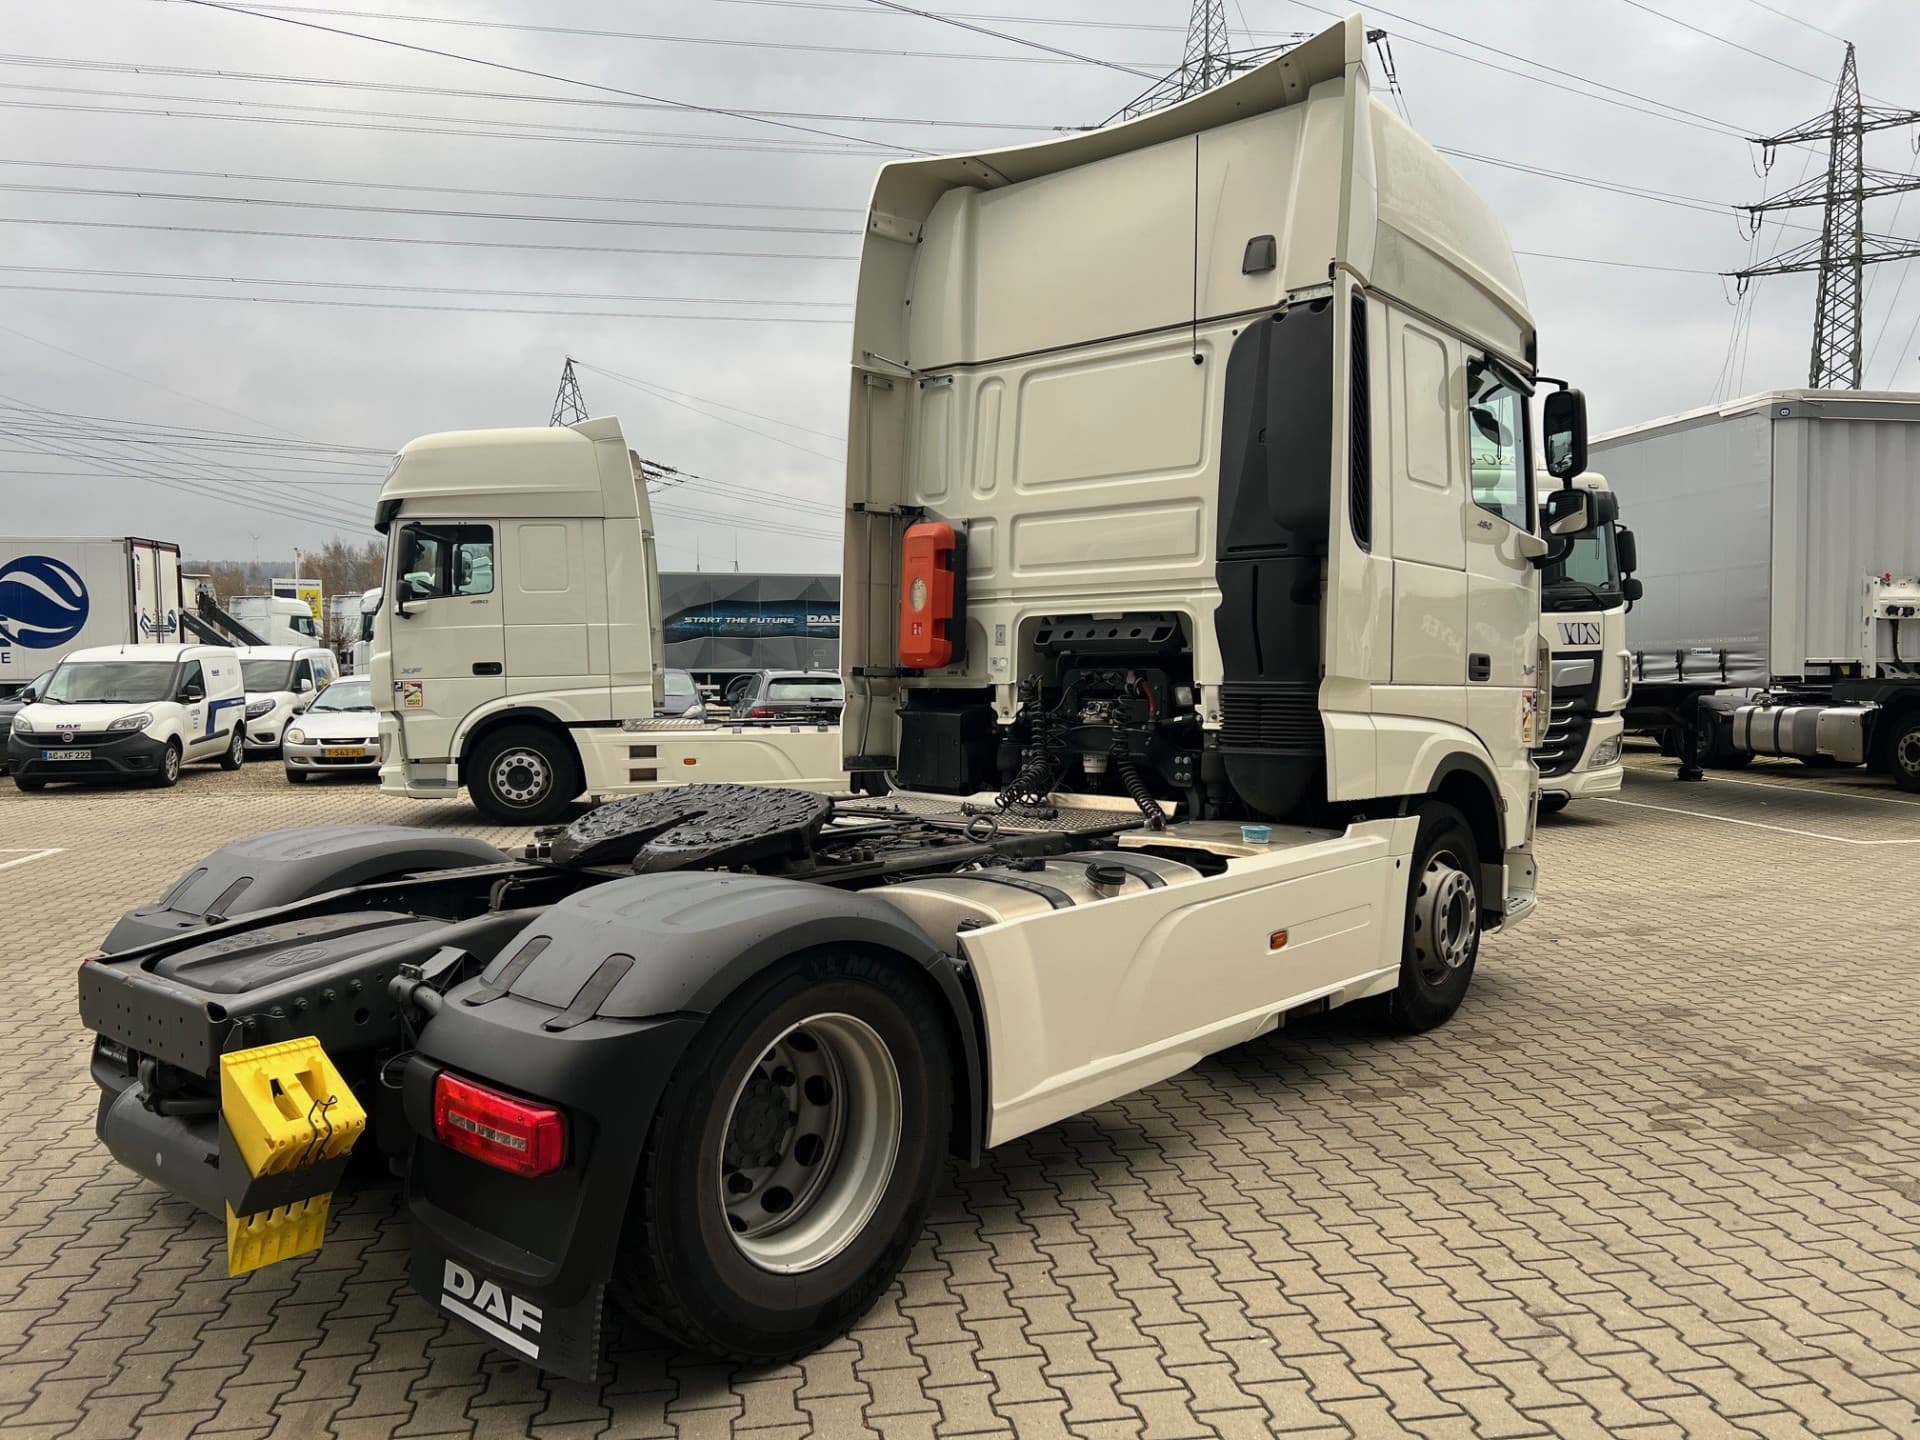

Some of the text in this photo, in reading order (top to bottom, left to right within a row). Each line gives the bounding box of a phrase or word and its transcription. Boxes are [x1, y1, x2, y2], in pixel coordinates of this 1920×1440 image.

[683, 616, 796, 624] START THE FUTURE
[442, 1259, 543, 1333] DAF
